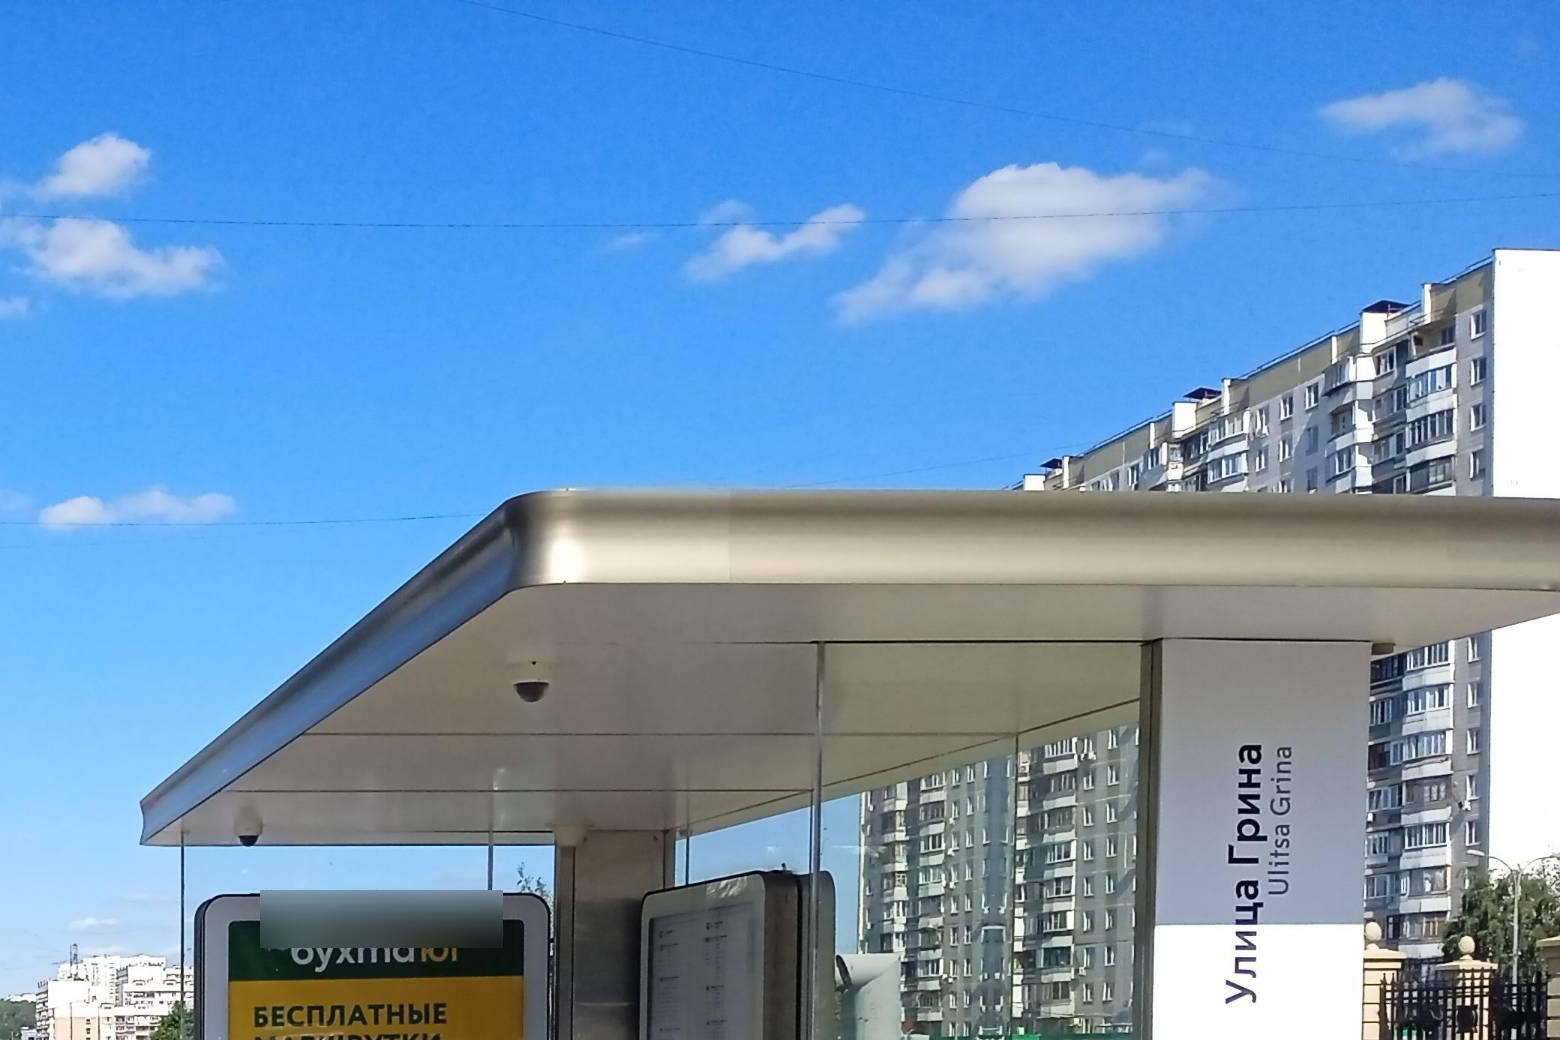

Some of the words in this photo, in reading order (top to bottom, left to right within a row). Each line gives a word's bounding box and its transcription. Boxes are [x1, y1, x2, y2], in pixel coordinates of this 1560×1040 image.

[1228, 744, 1268, 864] Грина
[1270, 746, 1292, 816] Grina
[1268, 824, 1290, 895] Ulitsa
[1225, 880, 1264, 1004] Улица
[254, 1003, 447, 1028] БЕСПЛАТНЫЕ
